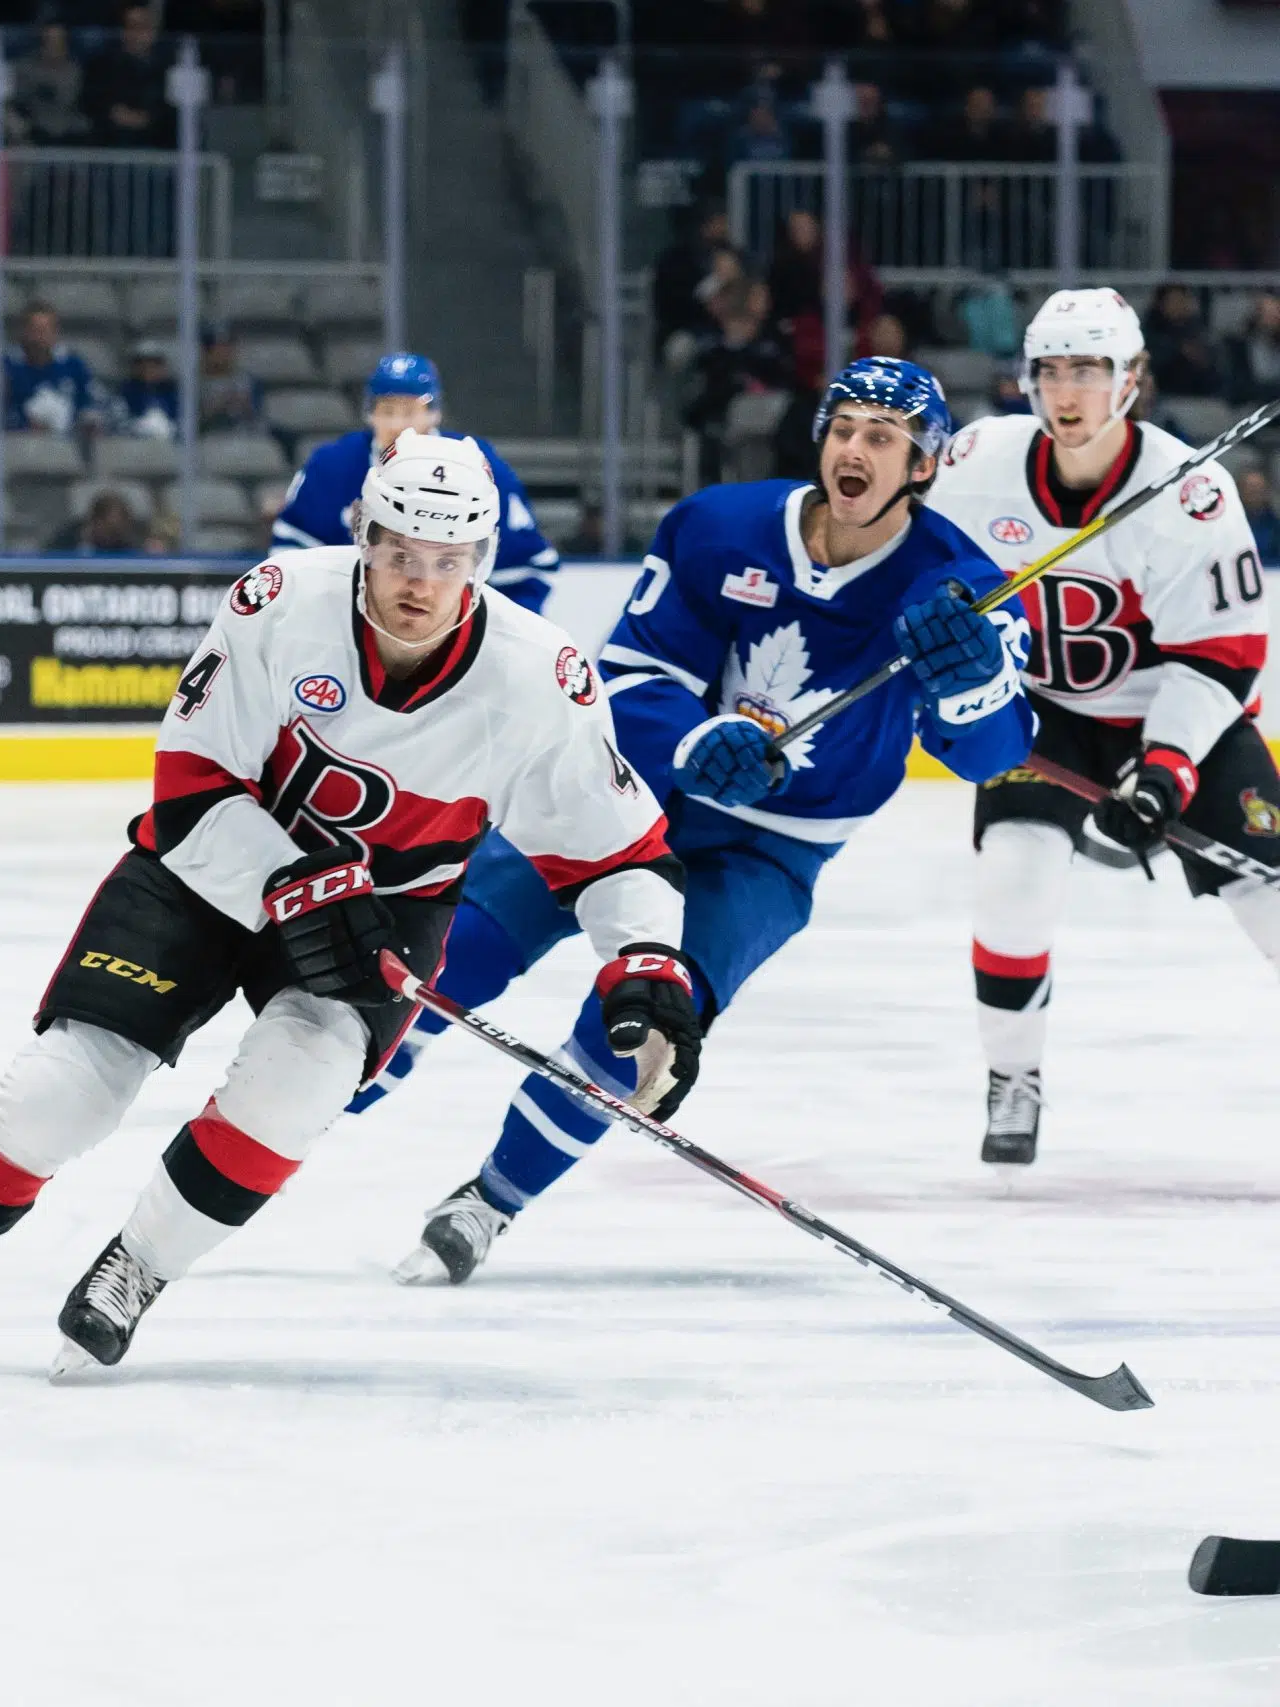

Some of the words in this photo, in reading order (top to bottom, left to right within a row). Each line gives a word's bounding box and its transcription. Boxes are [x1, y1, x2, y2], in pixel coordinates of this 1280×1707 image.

[432, 465, 446, 483] 4
[414, 509, 460, 522] CCM
[1207, 547, 1263, 613] 10
[42, 584, 179, 625] ONTARIO
[1036, 574, 1144, 700] B
[175, 648, 228, 721] 4
[302, 678, 339, 706] CAA
[272, 865, 373, 922] CCM
[80, 951, 178, 994] CCM
[464, 1012, 521, 1047] CCM
